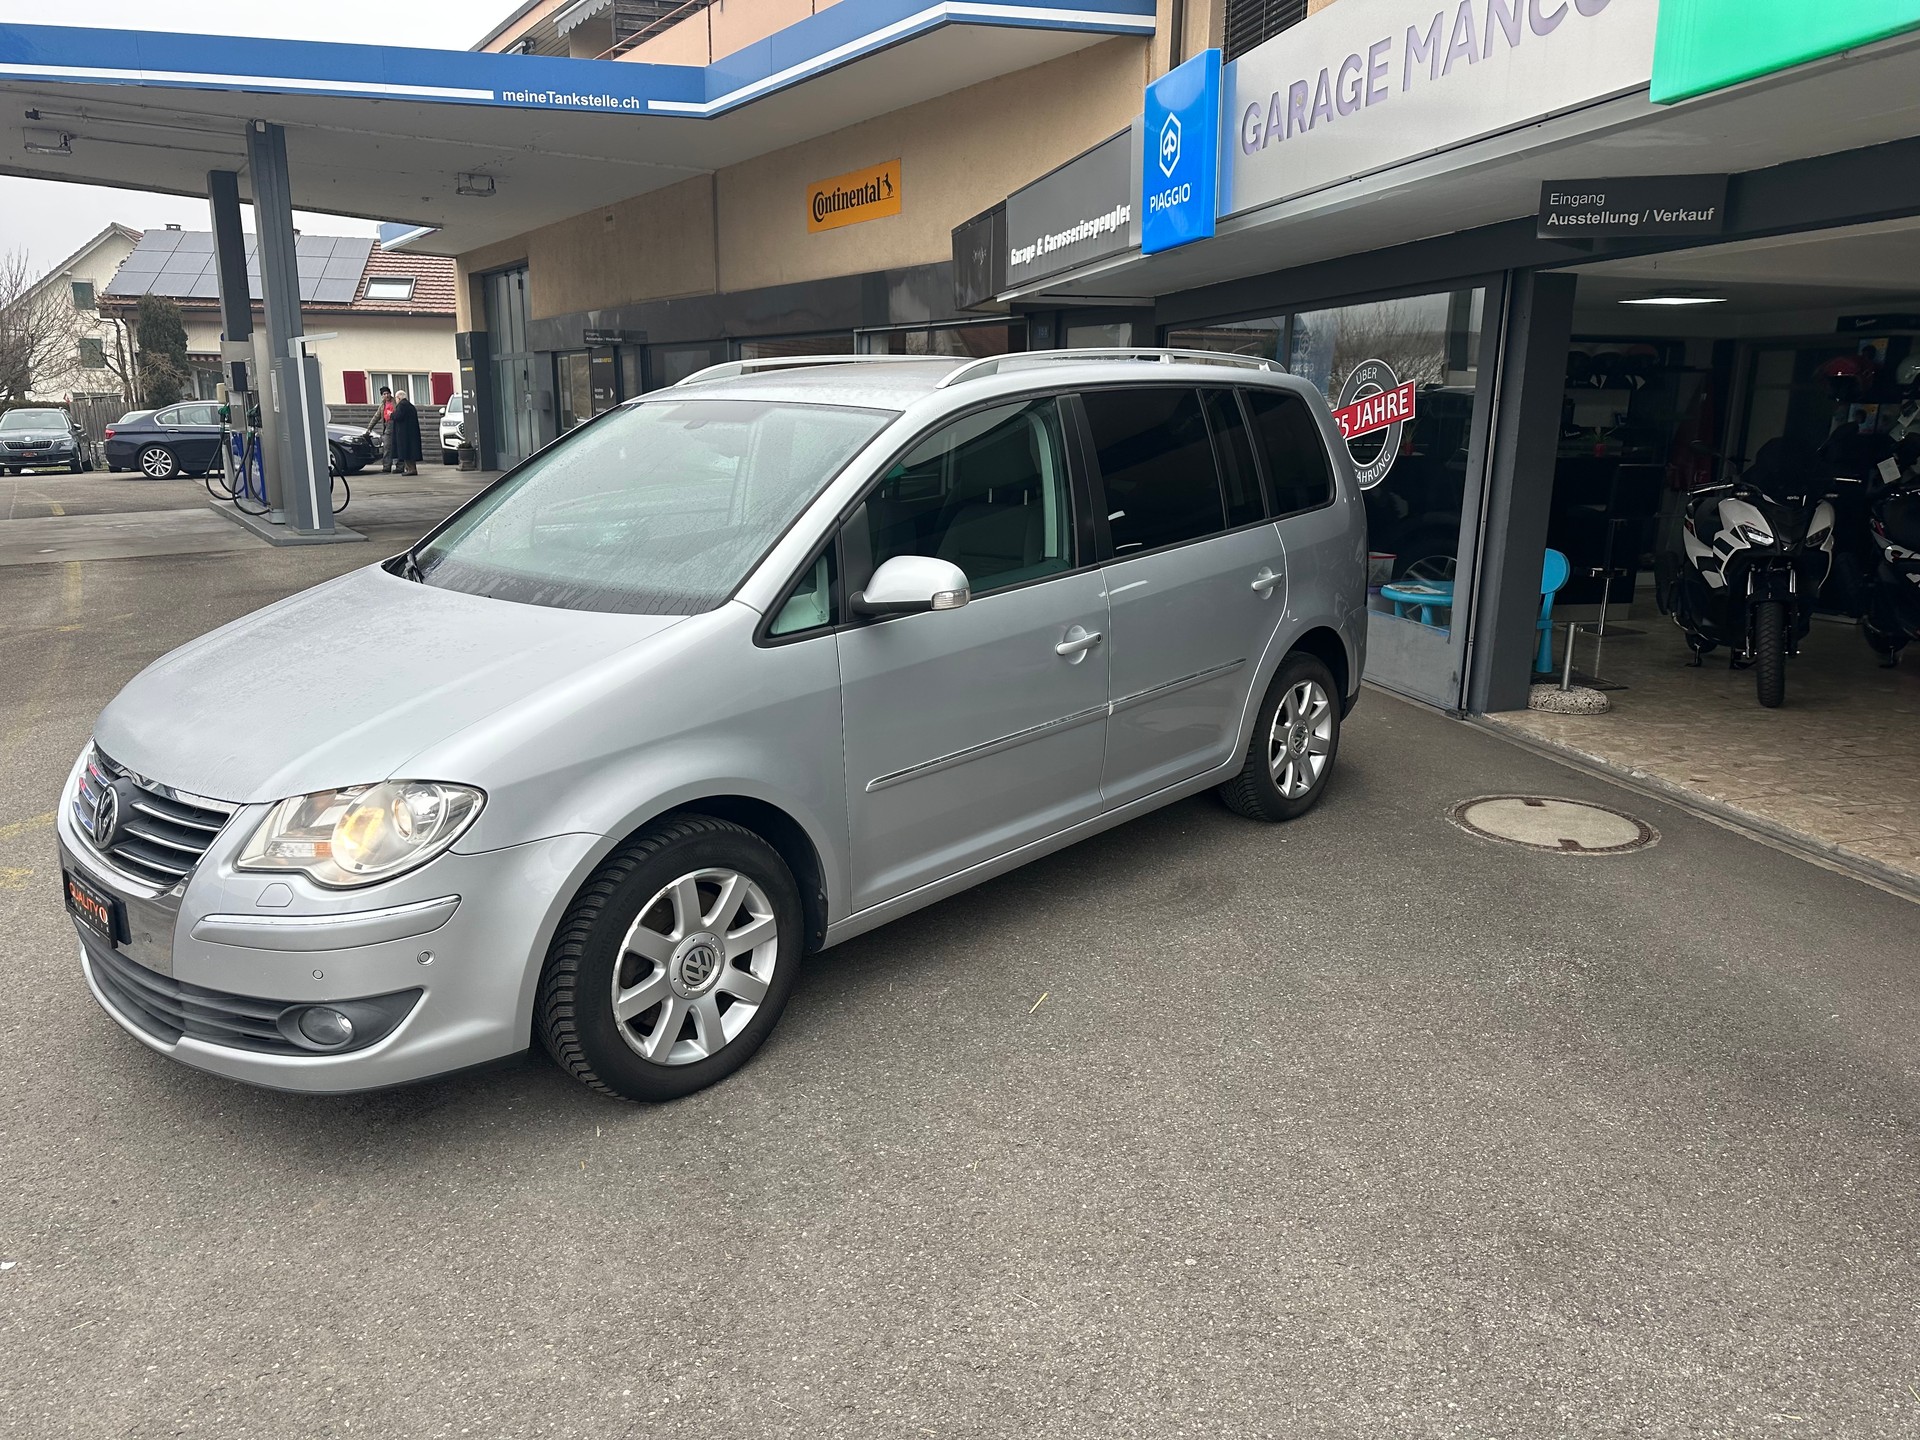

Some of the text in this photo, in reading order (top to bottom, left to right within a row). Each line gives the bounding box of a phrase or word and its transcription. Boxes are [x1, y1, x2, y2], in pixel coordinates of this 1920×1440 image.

[1241, 0, 1612, 156] GARAGE MANC
[502, 89, 640, 109] meineTankstelle.ch
[812, 176, 882, 223] Continental
[1149, 183, 1191, 214] PIAGGIO
[1550, 193, 1605, 208] Eingang
[1547, 210, 1639, 226] Ausstellung
[1653, 207, 1715, 222] Verkauf
[1011, 244, 1036, 266] Garage
[1036, 237, 1043, 256] &
[1355, 367, 1377, 385] ÜBER
[1353, 387, 1409, 431] JAHRE
[1354, 450, 1391, 483] AHRUNG
